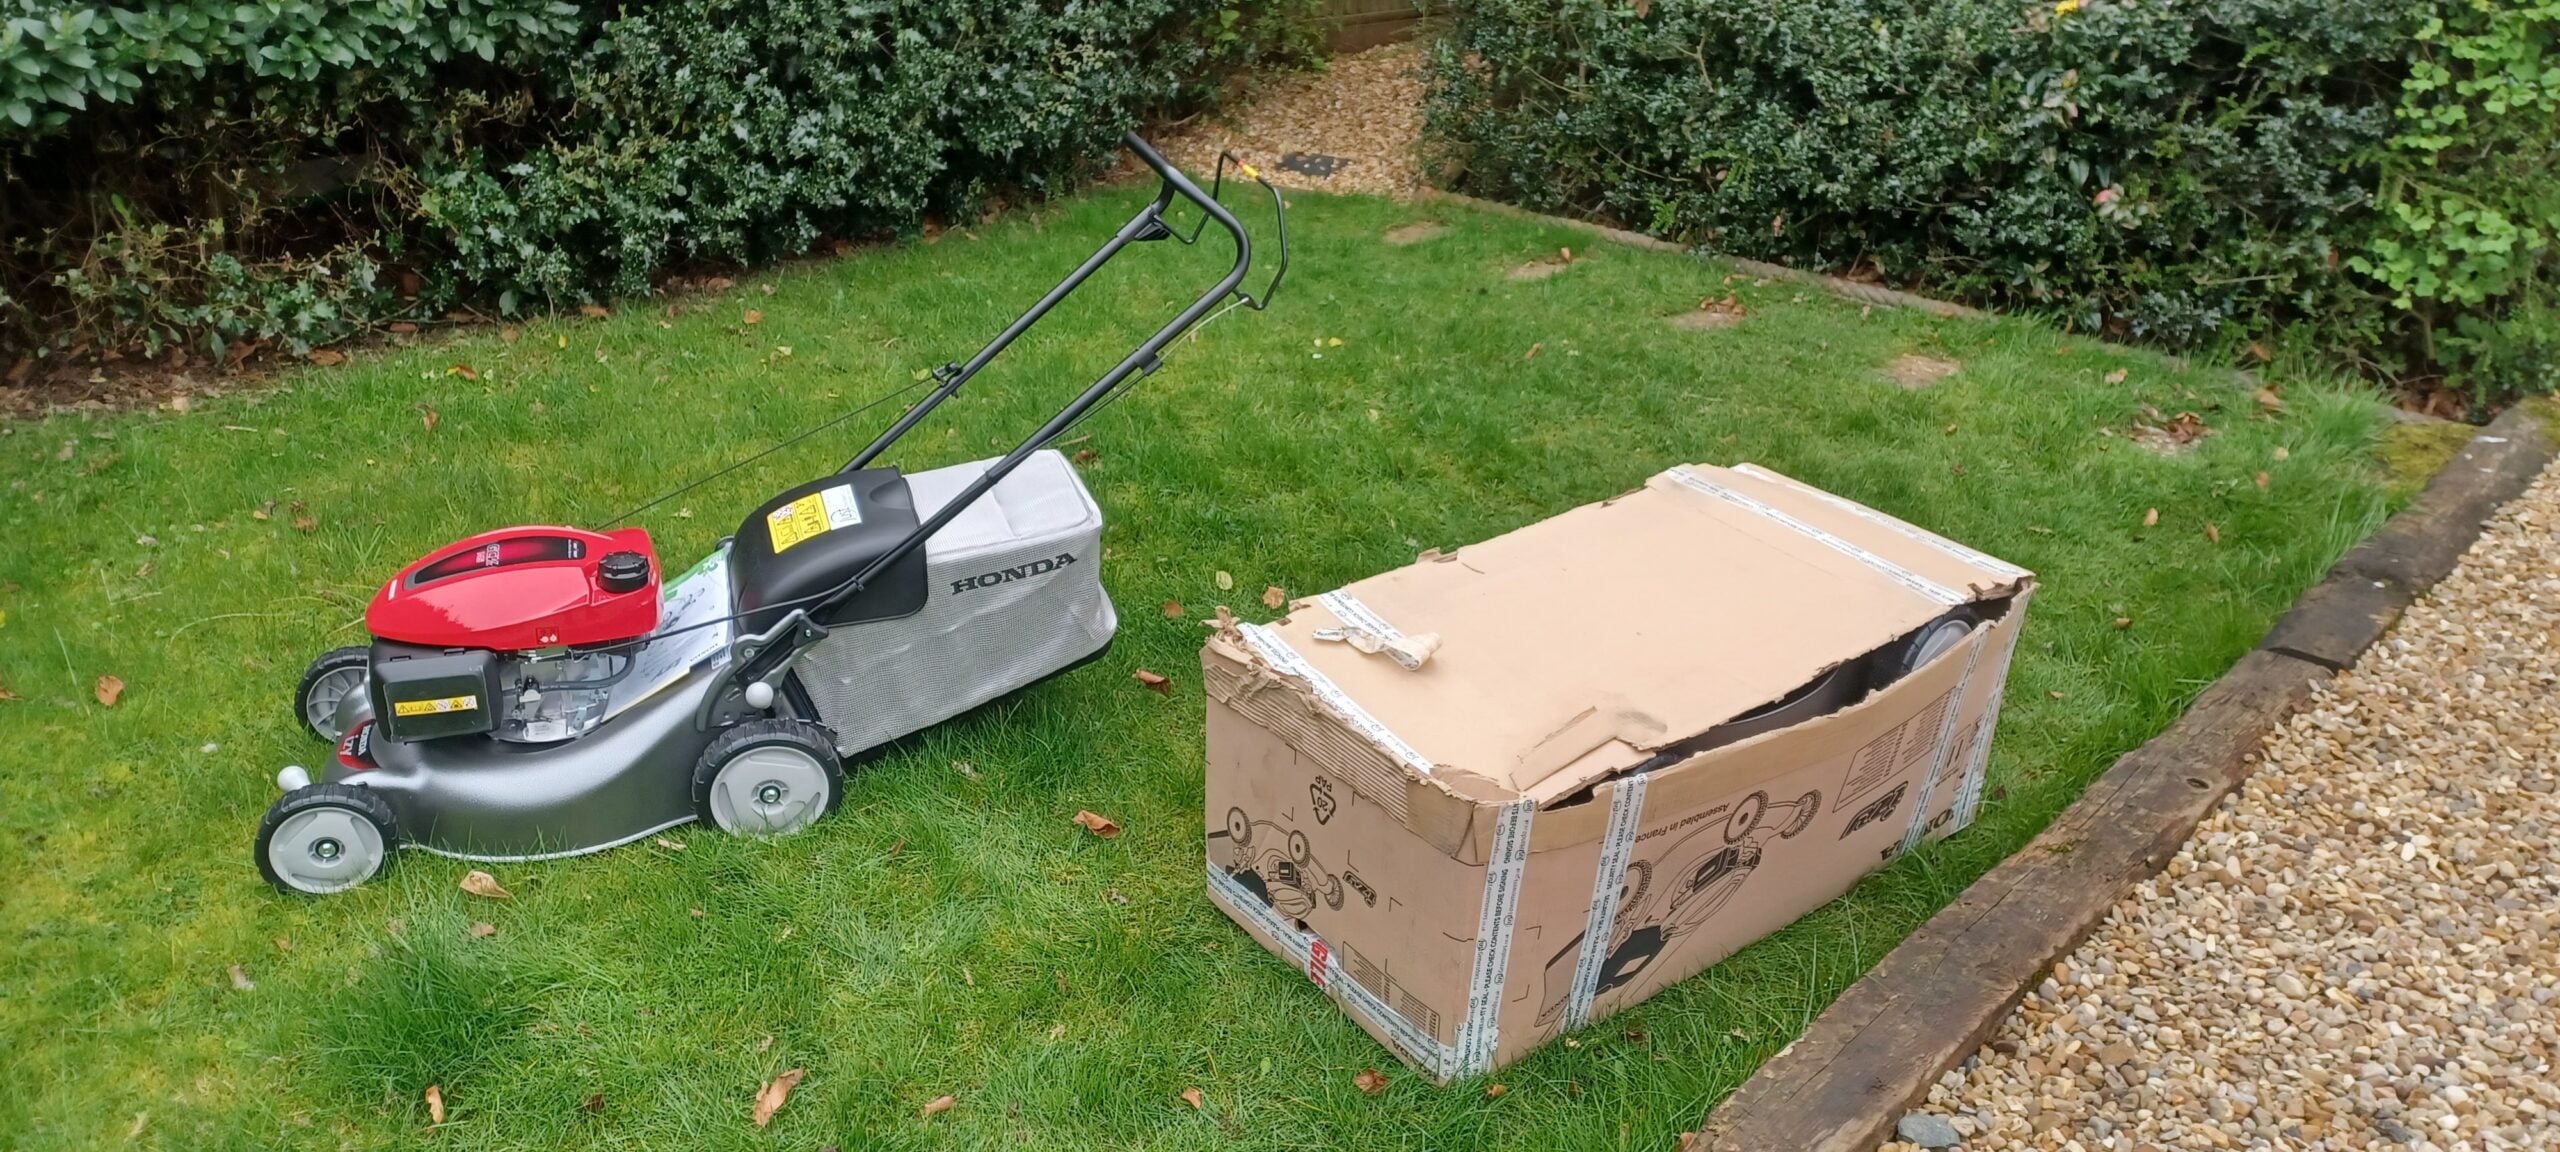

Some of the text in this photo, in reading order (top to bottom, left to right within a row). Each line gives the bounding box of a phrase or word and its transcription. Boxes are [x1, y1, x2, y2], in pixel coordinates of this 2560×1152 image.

[950, 552, 1078, 596] HONDA
[1315, 774, 1333, 792] PAP
[1316, 798, 1328, 811] 20
[1619, 807, 1629, 826] CHECK
[1506, 814, 1518, 840] BEFORE
[1634, 802, 1731, 843] Assembled in France
[1614, 825, 1626, 848] PLEASE
[1502, 839, 1514, 864] SIGNING
[1611, 848, 1620, 864] SEAL
[1497, 867, 1509, 892] SIGNING
[1493, 891, 1505, 917] BEFORE
[1488, 915, 1502, 948] CONTENTS
[1486, 948, 1496, 967] CHECK
[1482, 966, 1493, 989] PLEASE
